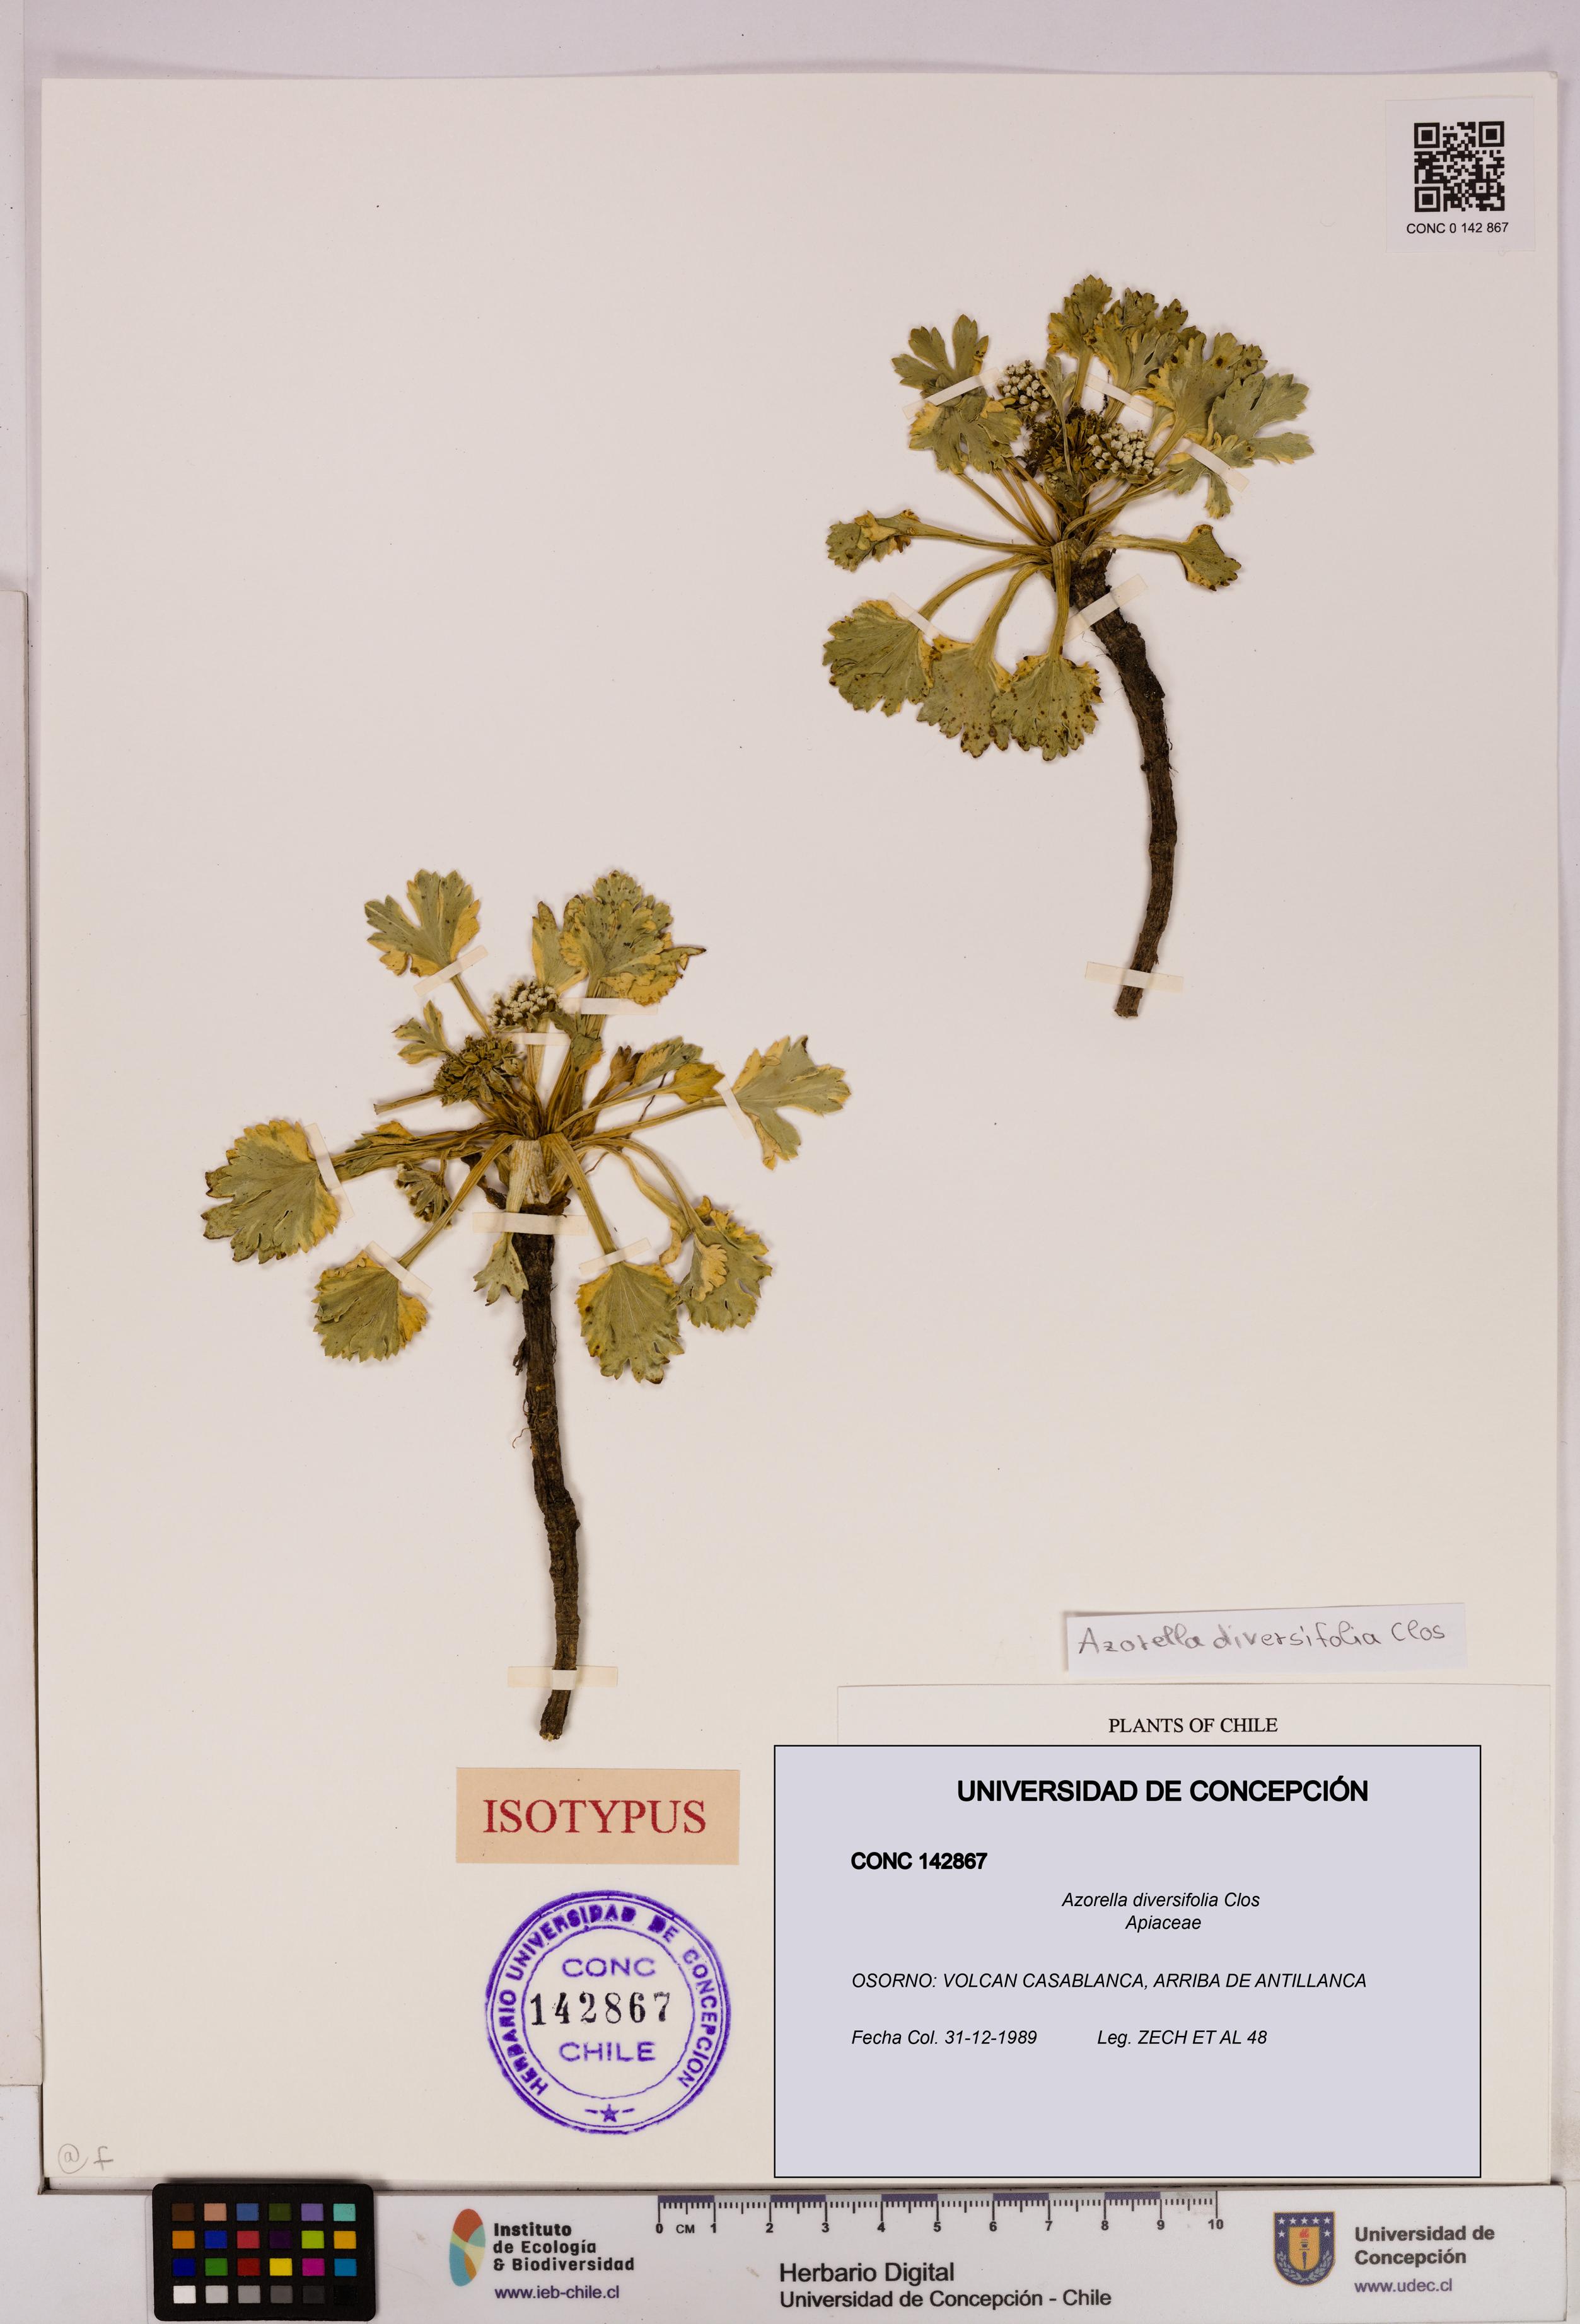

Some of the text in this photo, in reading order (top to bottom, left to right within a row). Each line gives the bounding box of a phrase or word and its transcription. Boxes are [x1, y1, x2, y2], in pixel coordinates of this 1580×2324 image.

[1407, 223, 1509, 234] CONC 0 142 867
[1078, 1620, 1444, 1654] Azorella diversifolia Clos
[1108, 1718, 1278, 1733] PLANTS OF CHILE
[483, 1799, 707, 1834] ISOTYPUS
[562, 1957, 656, 1978] CONC
[498, 1904, 718, 2096] HERBARIO UNIVERSIDAD DE CONCEPCION
[530, 1991, 671, 2026] 142867
[559, 2041, 656, 2062] CHILE
[494, 2222, 572, 2236] Instituto
[656, 2219, 1224, 2234] 0 CM 1 2 3 4 5 6 7 8 9 10
[1356, 2225, 1495, 2241] Universidad de
[493, 2240, 596, 2256] de Ecología
[494, 2257, 634, 2271] & Biodiversidad
[1355, 2248, 1466, 2268] Concepción
[781, 2262, 954, 2286] Herbario Digital
[494, 2285, 619, 2299] www.ieb-chile.cl
[1354, 2278, 1452, 2292] www.udec.cl
[781, 2291, 893, 2308] Universidad
[899, 2291, 923, 2307] de
[929, 2290, 1043, 2310] Concepción
[1063, 2289, 1112, 2306] Chile
